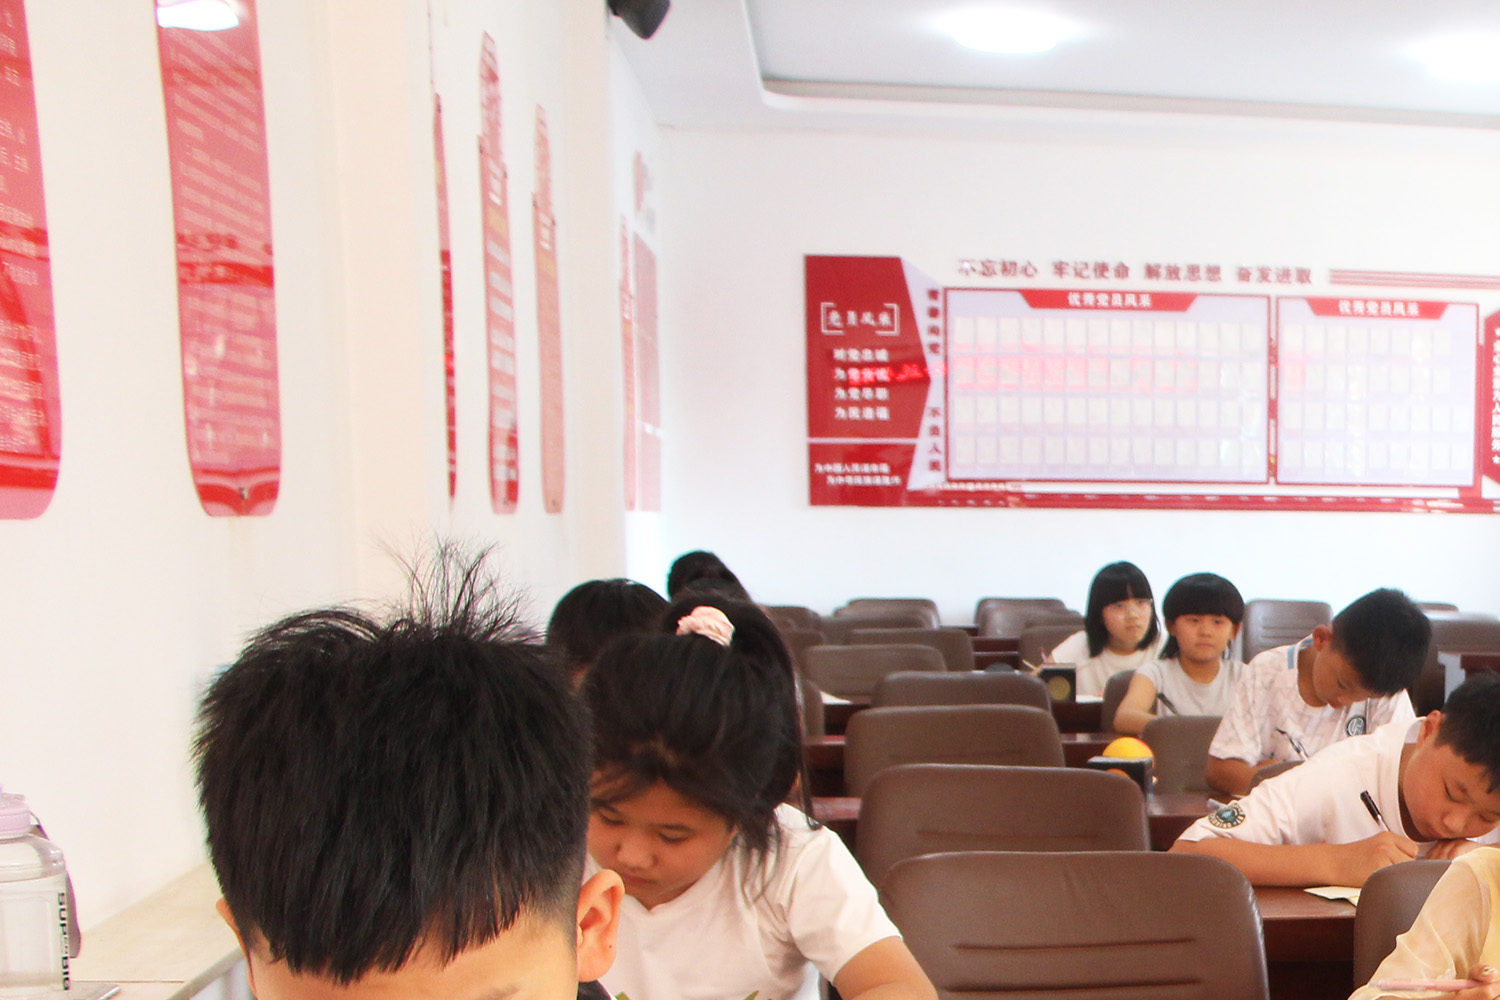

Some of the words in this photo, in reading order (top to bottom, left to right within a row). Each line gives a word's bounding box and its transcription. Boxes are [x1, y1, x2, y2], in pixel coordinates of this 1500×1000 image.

[958, 259, 1038, 278] 不忘初心
[1052, 260, 1130, 279] 牢记使命
[1144, 262, 1222, 282] 解放思想
[1237, 266, 1312, 285] 奋发进取
[1068, 292, 1151, 308] 优秀党员风采
[1338, 299, 1420, 317] 优秀党员风采
